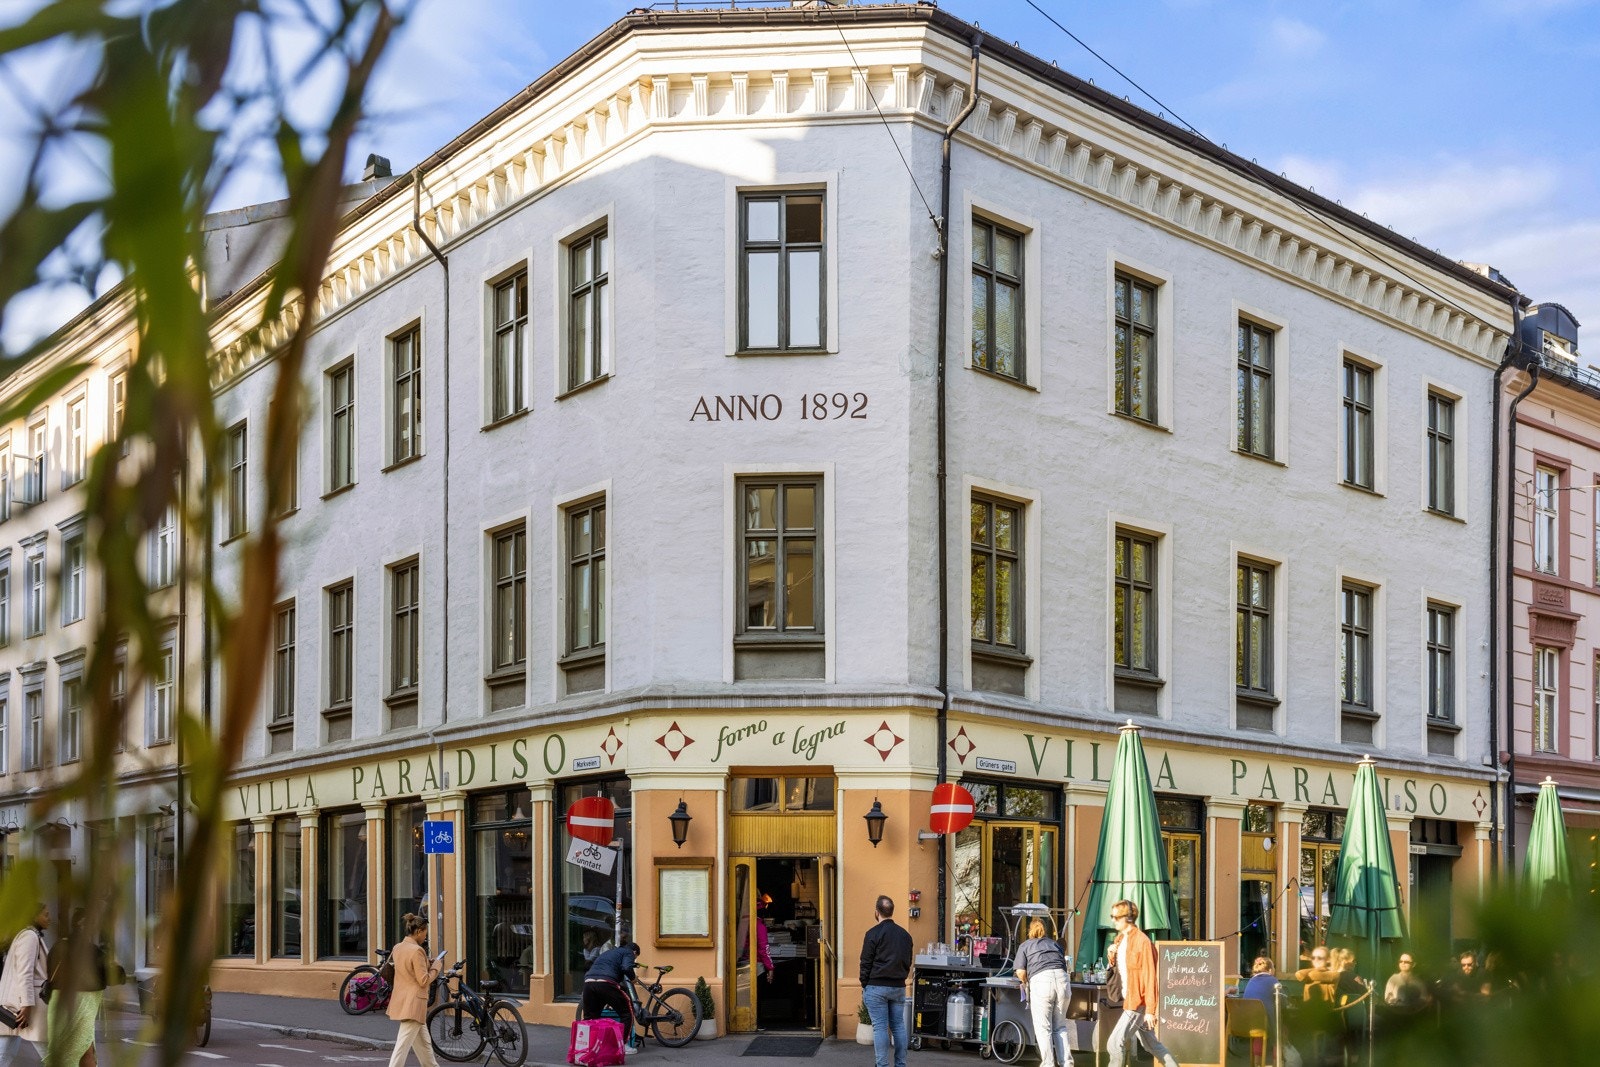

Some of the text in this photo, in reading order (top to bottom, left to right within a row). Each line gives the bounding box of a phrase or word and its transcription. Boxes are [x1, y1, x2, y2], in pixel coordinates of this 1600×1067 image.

[689, 392, 868, 421] ANNO 1892
[710, 719, 846, 762] forno a legna
[238, 733, 566, 816] VILLA PARADISO
[1023, 733, 1448, 816] VILA PARAISO
[1164, 946, 1210, 965] Aspettare
[1167, 962, 1210, 980] prima di
[1194, 995, 1217, 1007] wait
[1172, 1007, 1199, 1020] to be
